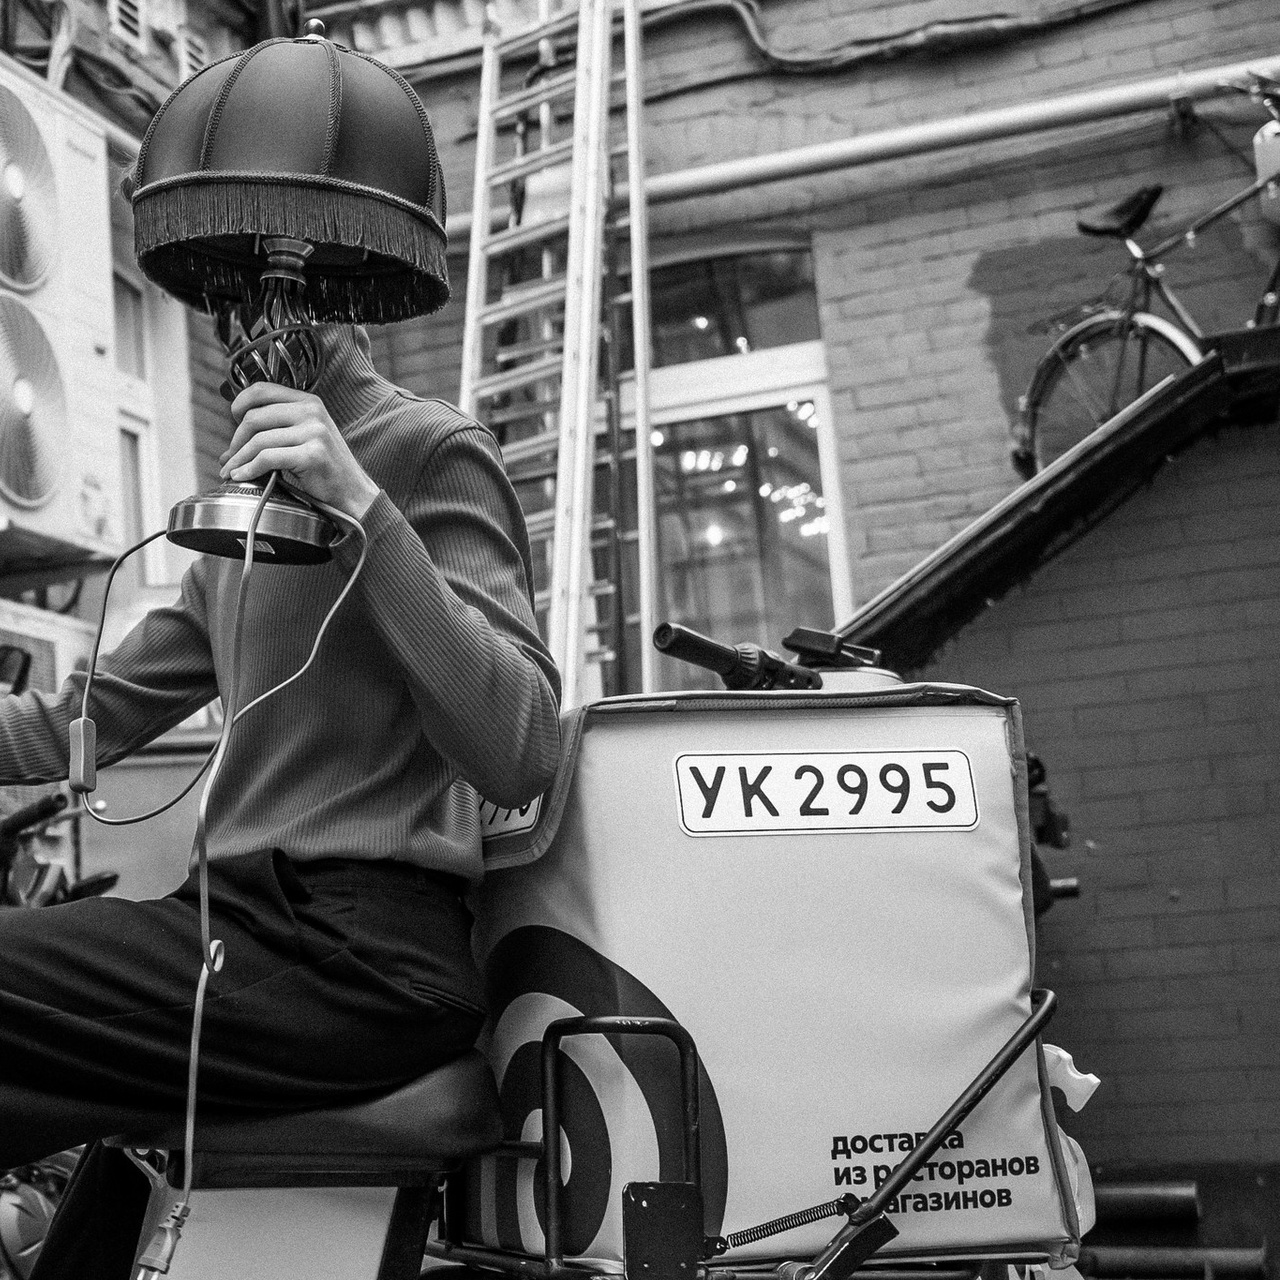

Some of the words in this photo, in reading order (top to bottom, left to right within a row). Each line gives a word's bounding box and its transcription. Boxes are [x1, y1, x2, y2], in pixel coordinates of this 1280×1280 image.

[831, 1130, 964, 1160] достаа
[834, 1166, 867, 1186] из
[873, 1156, 1040, 1190] рторанов
[880, 1188, 1012, 1214] агазинов
